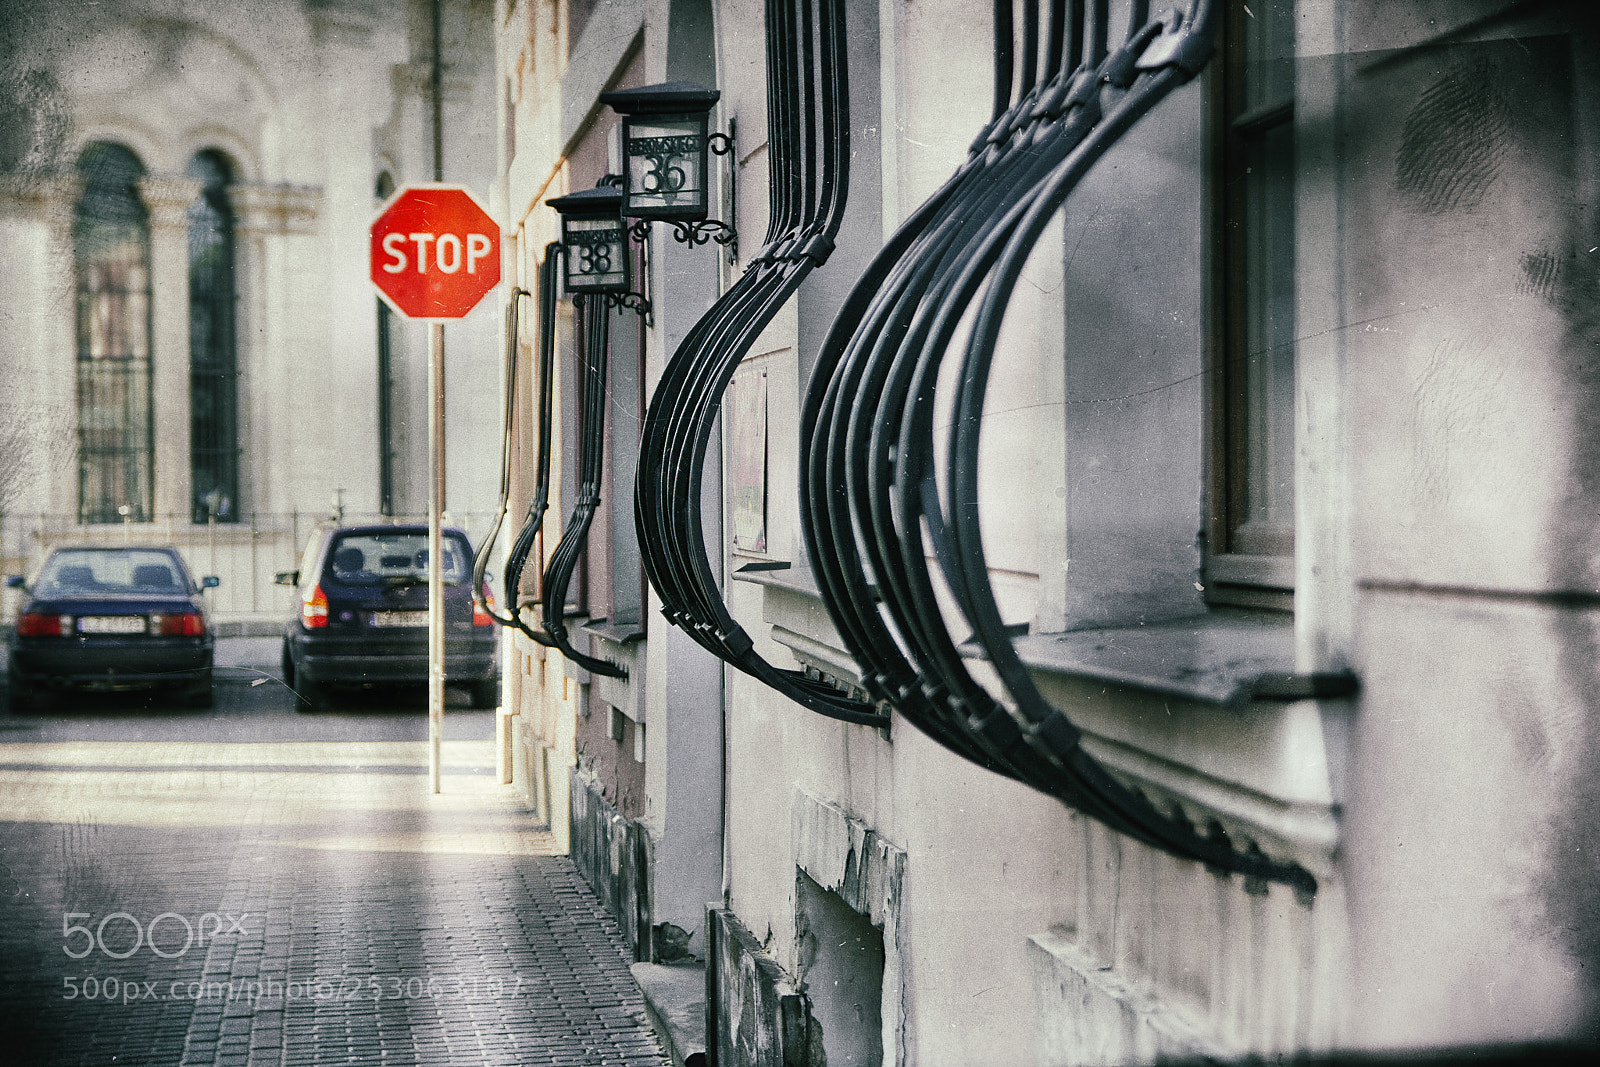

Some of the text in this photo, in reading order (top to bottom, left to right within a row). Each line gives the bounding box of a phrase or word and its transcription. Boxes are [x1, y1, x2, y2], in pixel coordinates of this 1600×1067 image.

[642, 151, 686, 193] 36
[382, 232, 492, 274] STOP
[580, 243, 611, 274] 38
